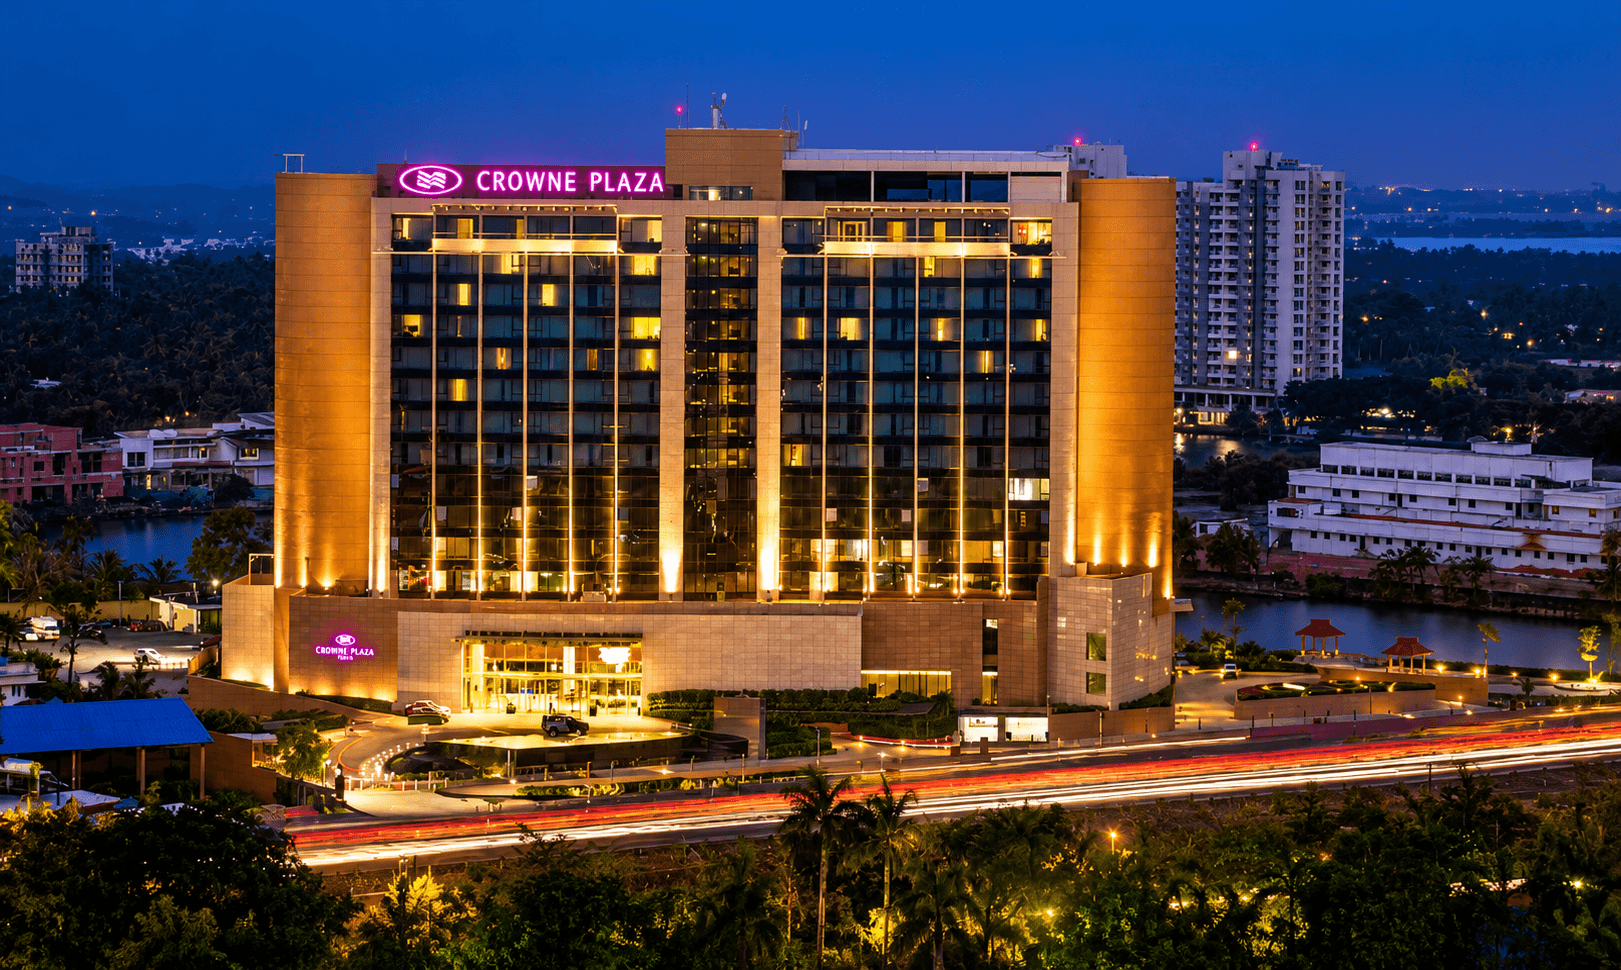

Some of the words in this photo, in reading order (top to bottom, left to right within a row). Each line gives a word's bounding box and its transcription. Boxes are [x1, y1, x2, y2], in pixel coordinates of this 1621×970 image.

[476, 170, 577, 192] CROWNE
[590, 171, 664, 193] PLAZA
[350, 647, 375, 656] PLAZA
